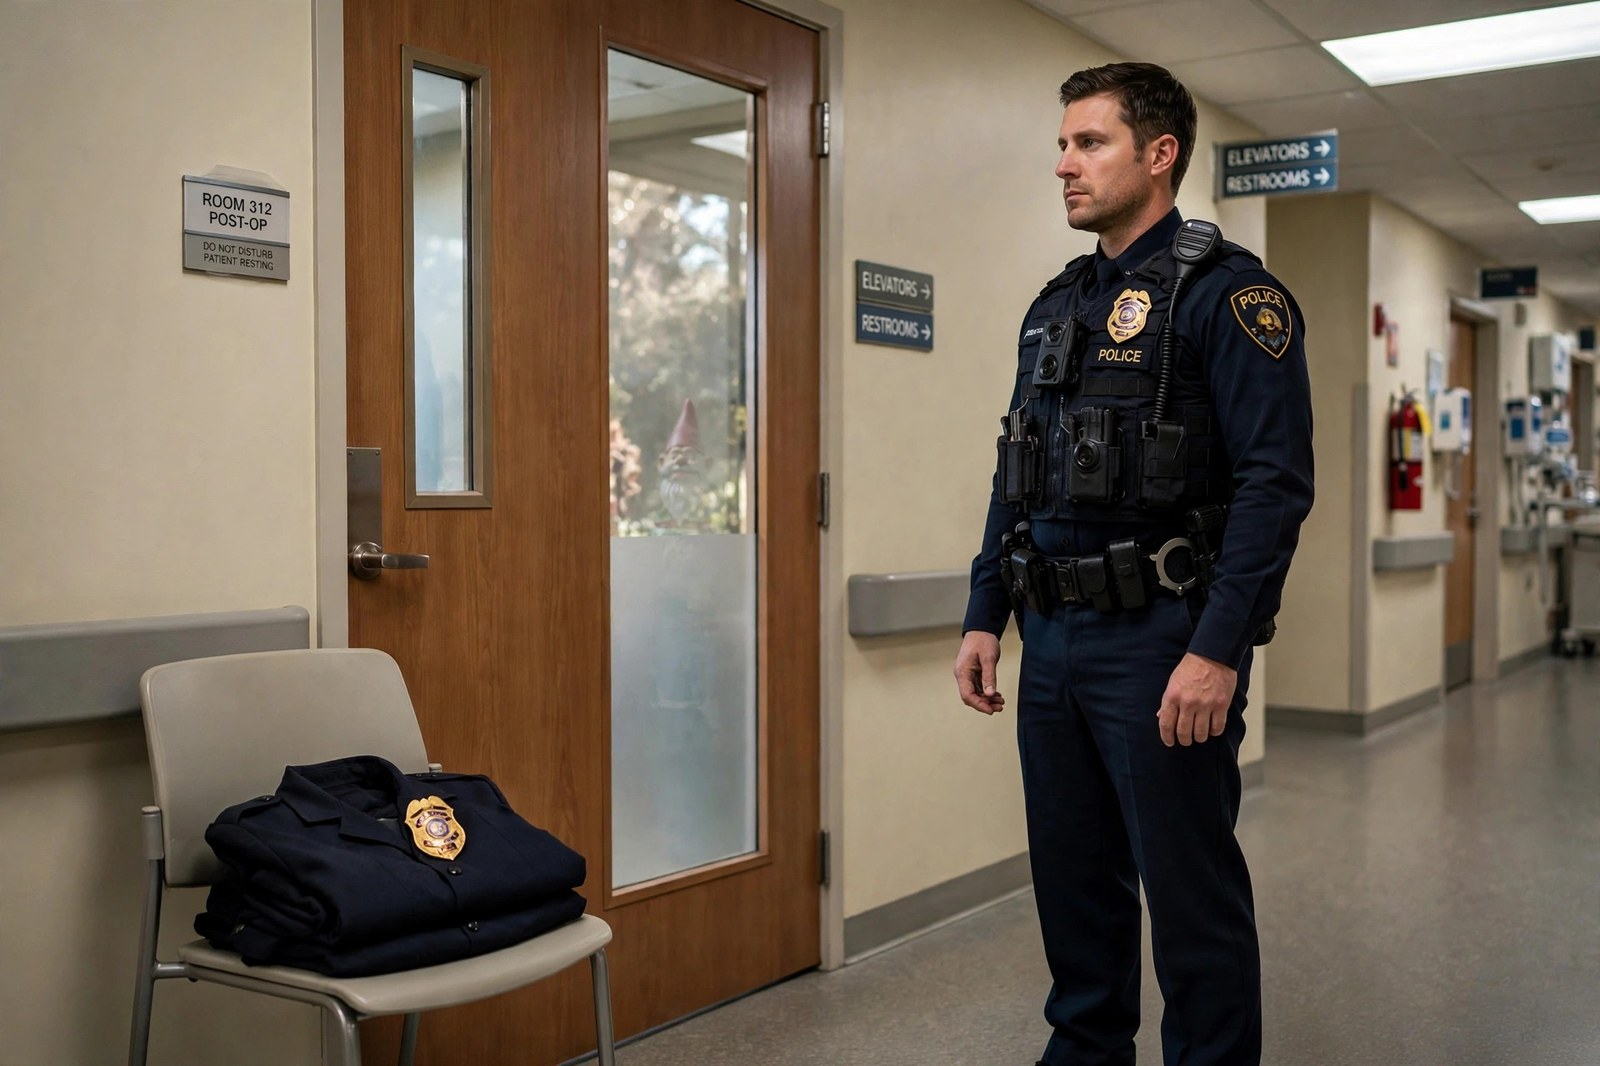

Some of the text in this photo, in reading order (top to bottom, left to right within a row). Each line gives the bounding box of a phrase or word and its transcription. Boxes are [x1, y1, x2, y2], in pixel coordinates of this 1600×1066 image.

[1227, 141, 1310, 167] ELEVATORS
[1226, 168, 1310, 193] RESTROOMS
[202, 192, 273, 216] ROOM 312
[209, 211, 268, 232] POST-OP
[203, 241, 273, 259] DO NOT DISTURB
[203, 253, 274, 270] PATIENT RESTING
[862, 270, 918, 298] ELEVATORS
[1238, 290, 1283, 310] POLICE
[861, 313, 919, 339] RESTROOMS
[1097, 348, 1142, 363] POLICE
